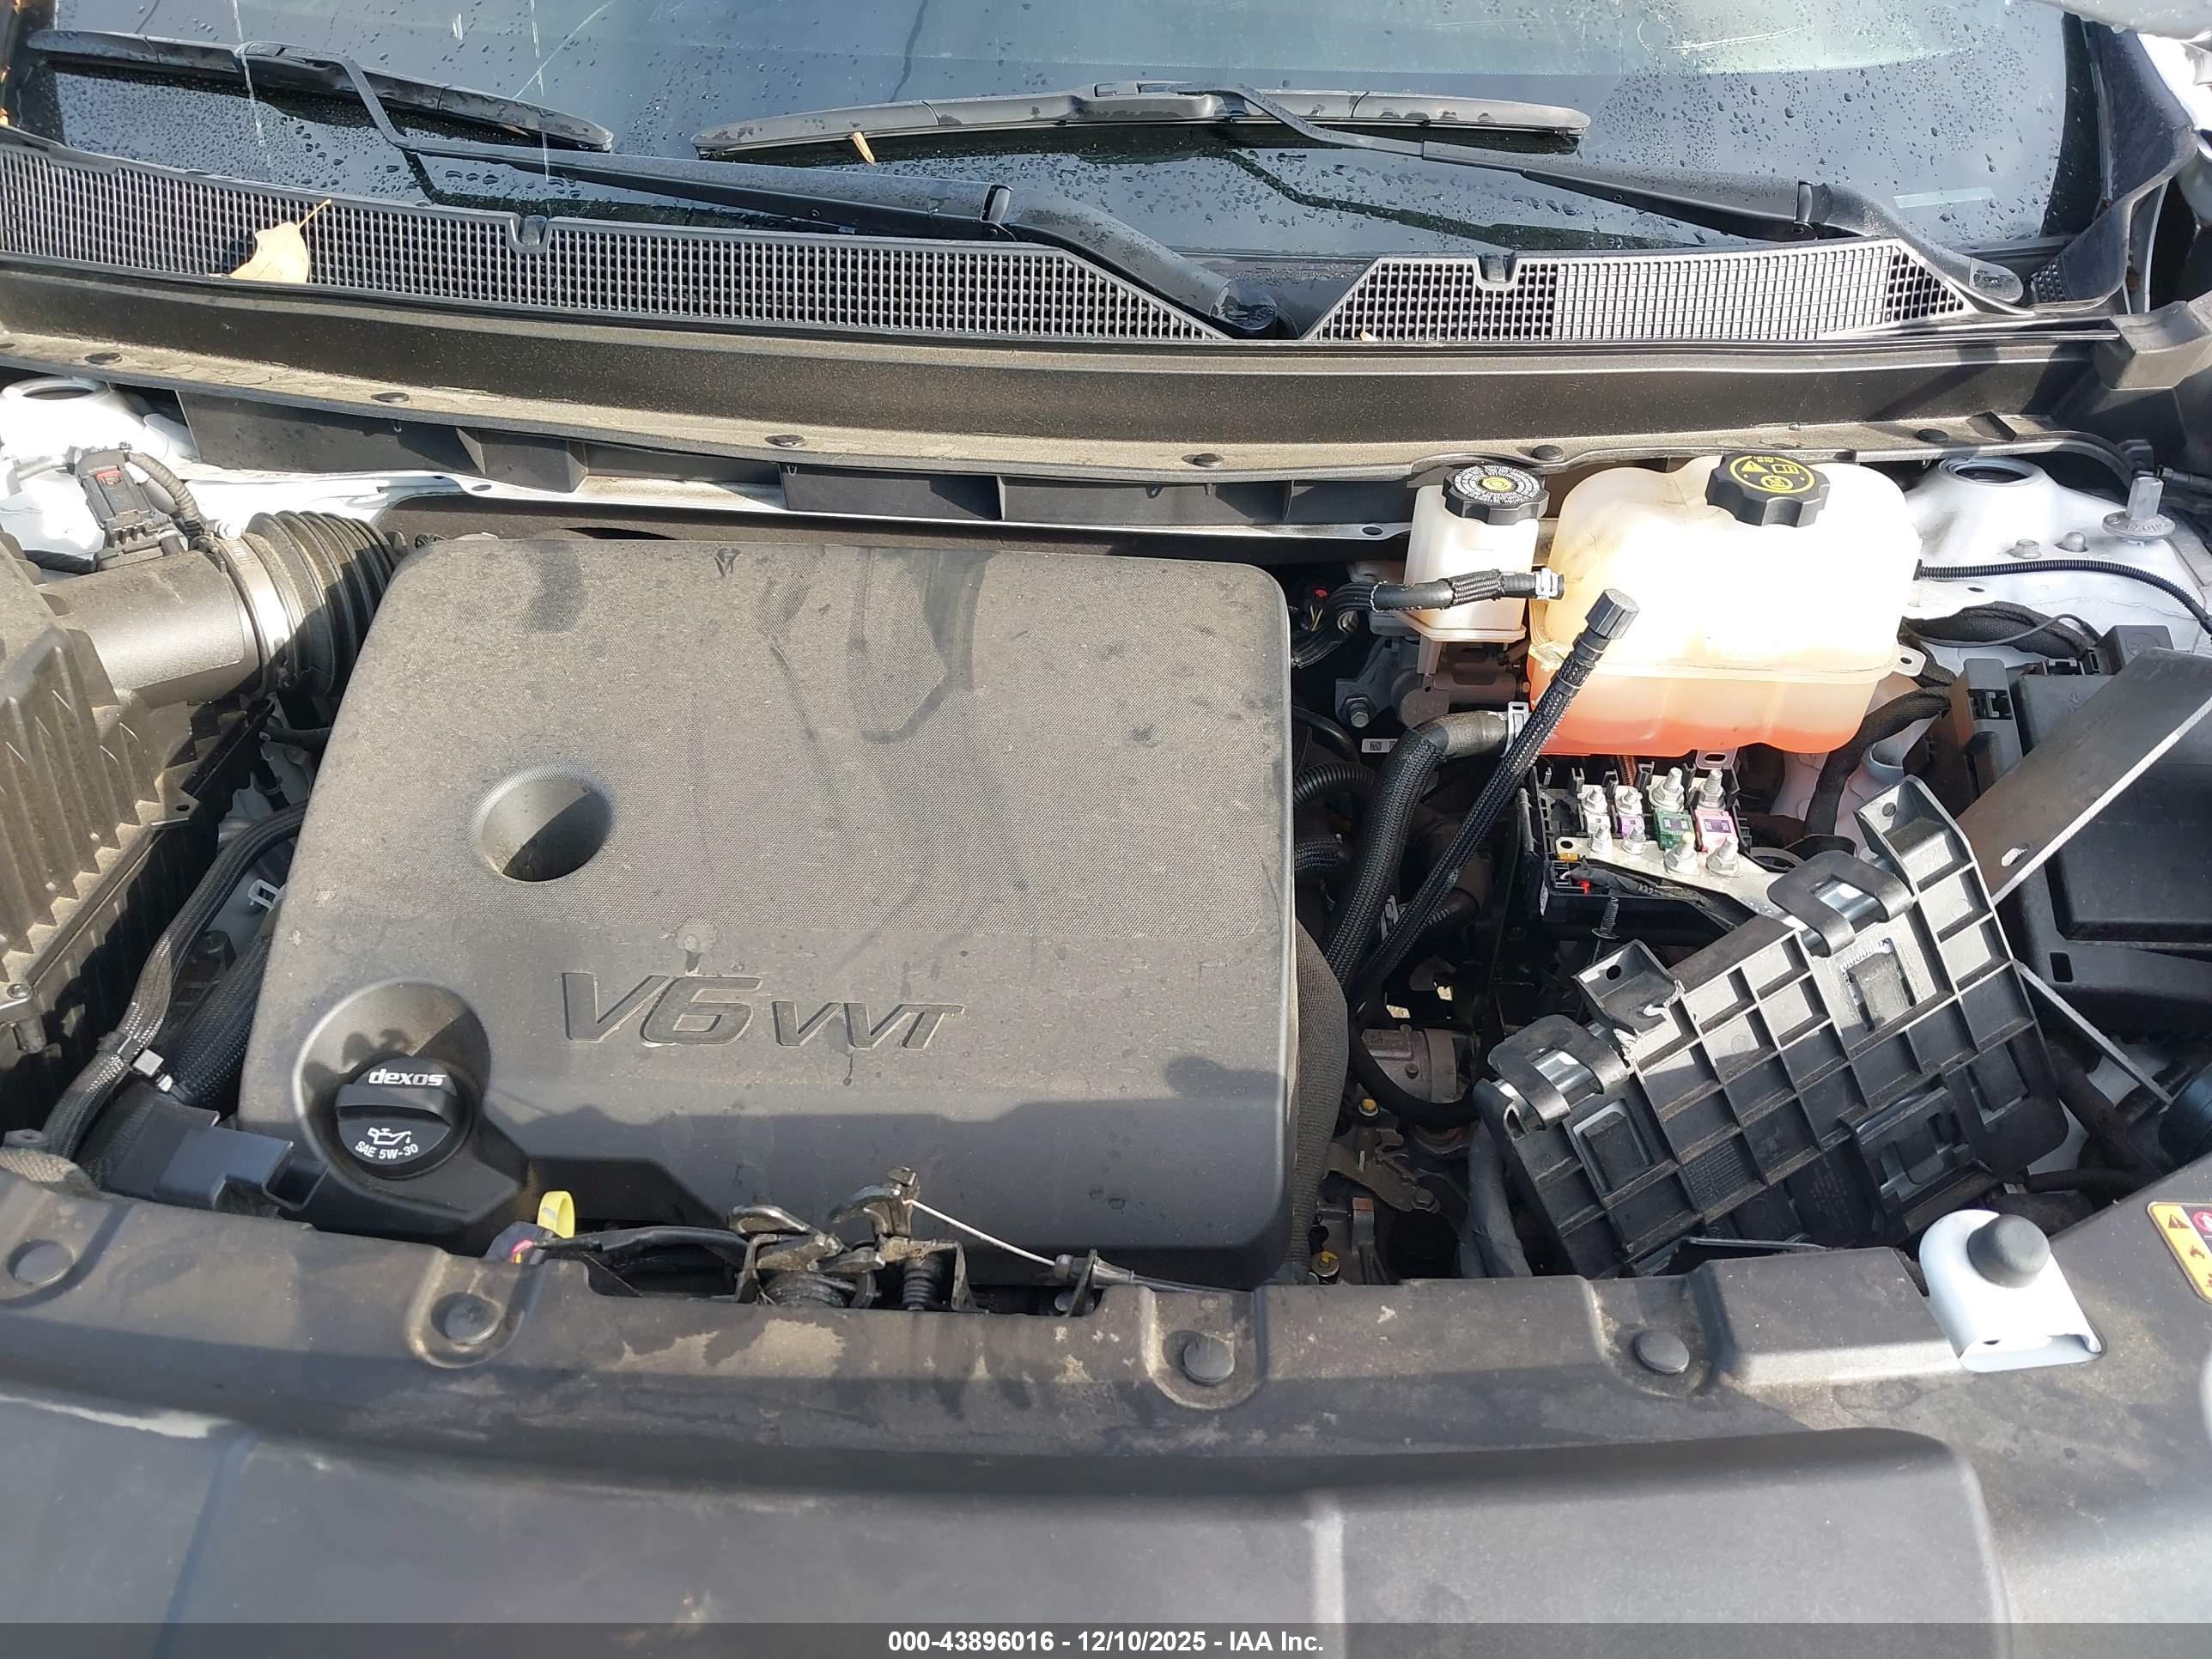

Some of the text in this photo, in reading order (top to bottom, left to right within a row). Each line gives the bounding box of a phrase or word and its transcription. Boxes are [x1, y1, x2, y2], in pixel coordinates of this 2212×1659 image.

[562, 971, 965, 1049] V6 VVT
[368, 1068, 447, 1086] dexos
[355, 1140, 419, 1160] SAE 5W-30
